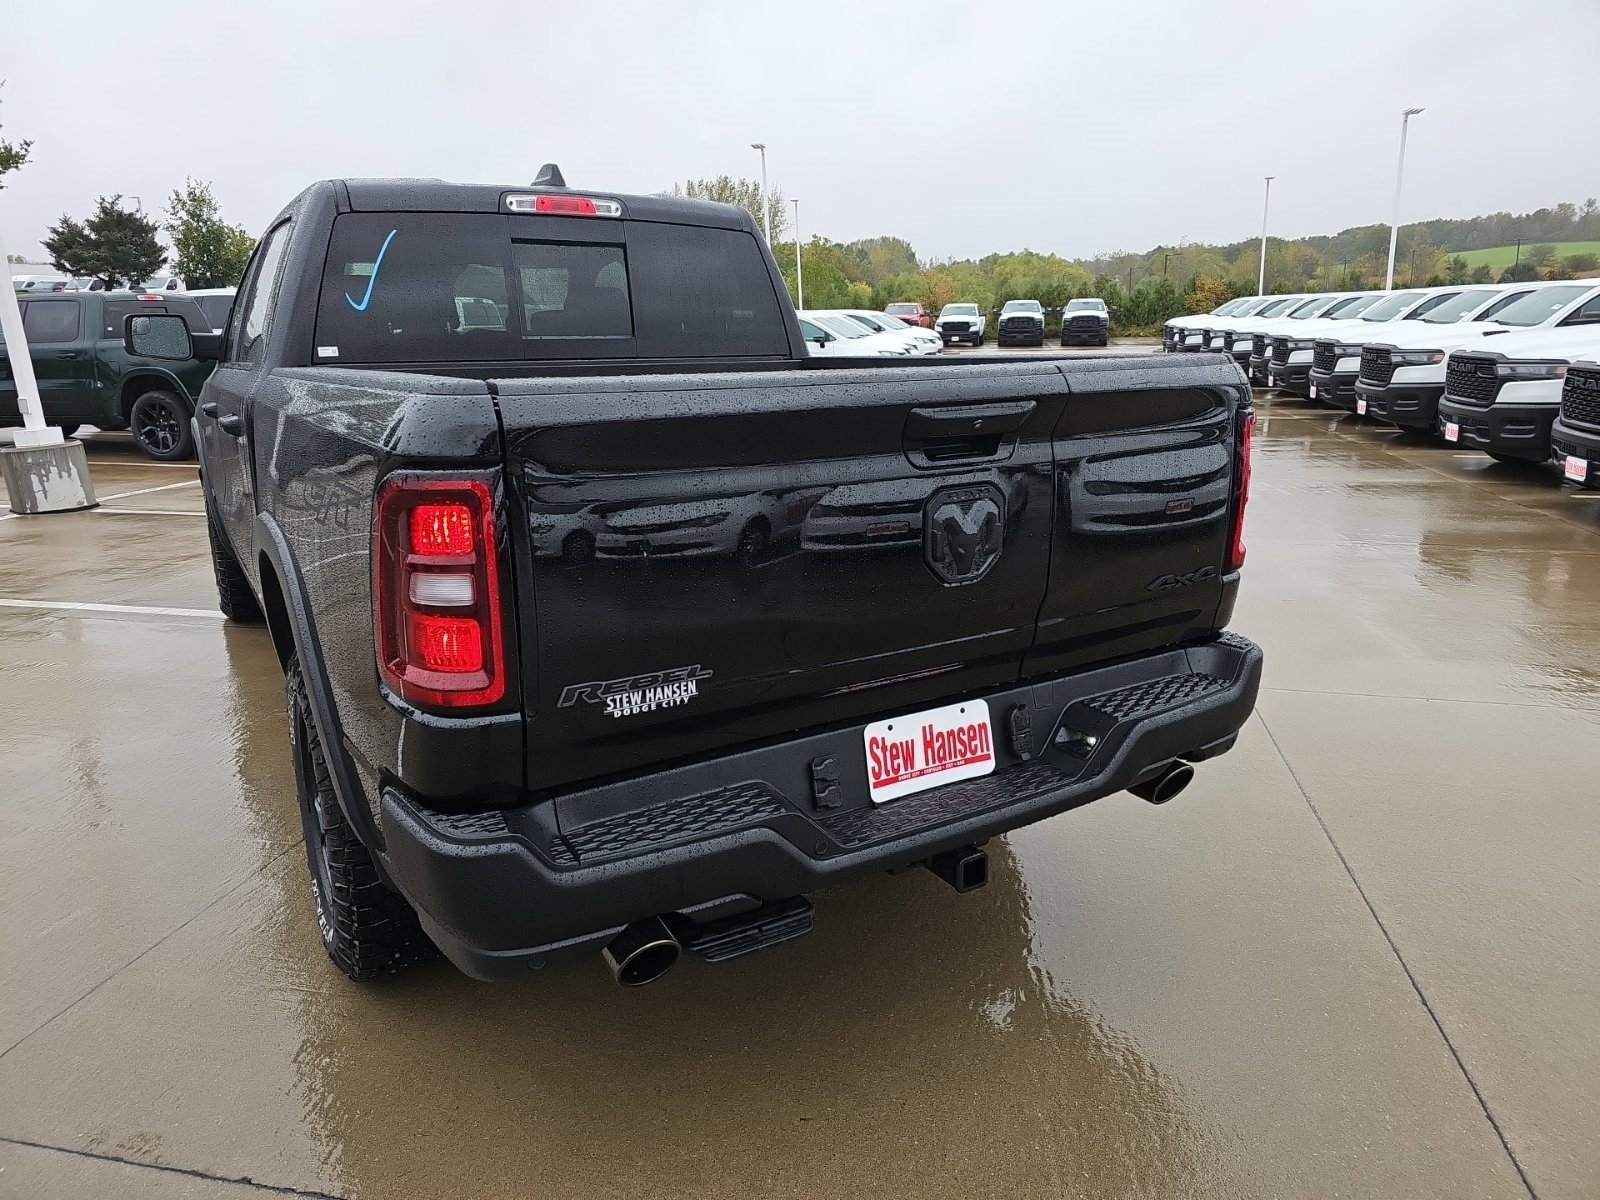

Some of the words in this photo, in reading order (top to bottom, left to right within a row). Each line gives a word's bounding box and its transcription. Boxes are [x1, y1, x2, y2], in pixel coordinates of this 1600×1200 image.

[1573, 376, 1600, 391] RA
[557, 664, 713, 707] REBEL
[606, 690, 643, 711] STEW
[646, 680, 697, 702] HANSEN
[613, 703, 657, 718] DODGE
[662, 697, 690, 709] CITY
[869, 736, 915, 780] Stew
[922, 721, 990, 766] Hansen
